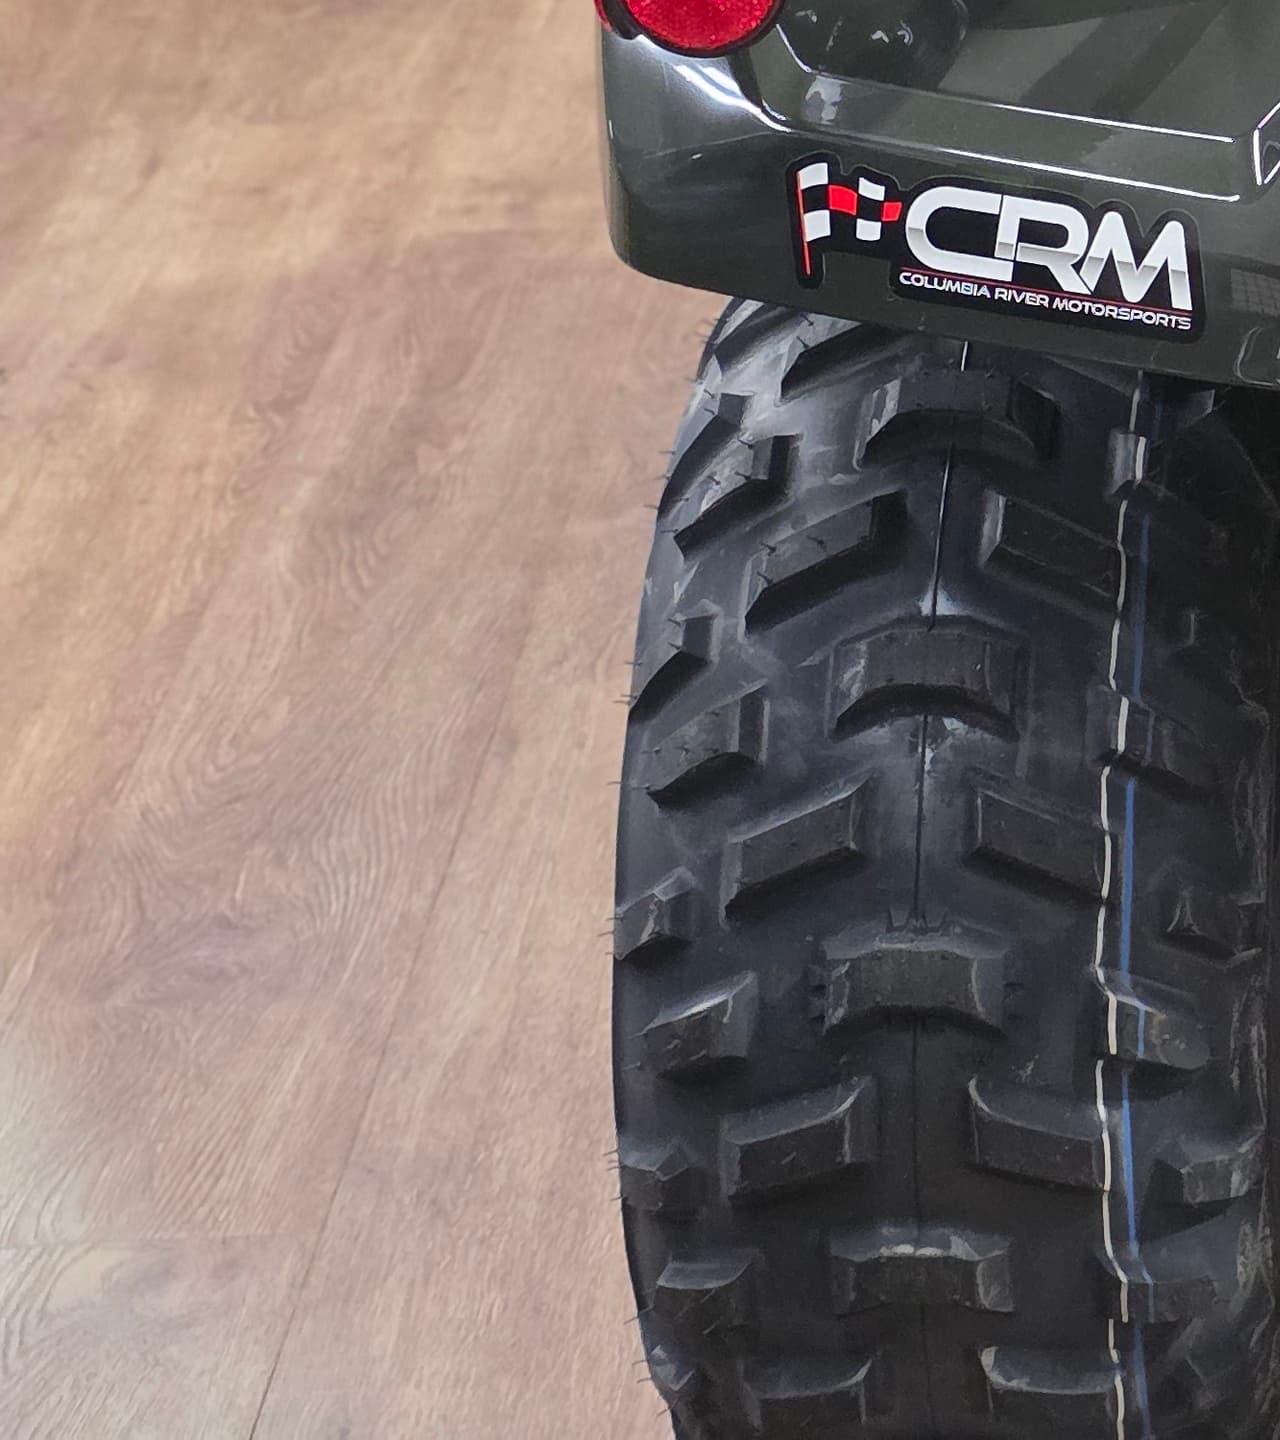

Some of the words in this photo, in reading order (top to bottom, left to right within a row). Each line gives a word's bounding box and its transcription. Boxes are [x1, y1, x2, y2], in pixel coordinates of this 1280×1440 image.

[904, 185, 1193, 311] CRM
[899, 271, 991, 299] COLUMBIA
[994, 287, 1050, 309] RIVER
[1052, 298, 1192, 330] MOTORSPORTS
